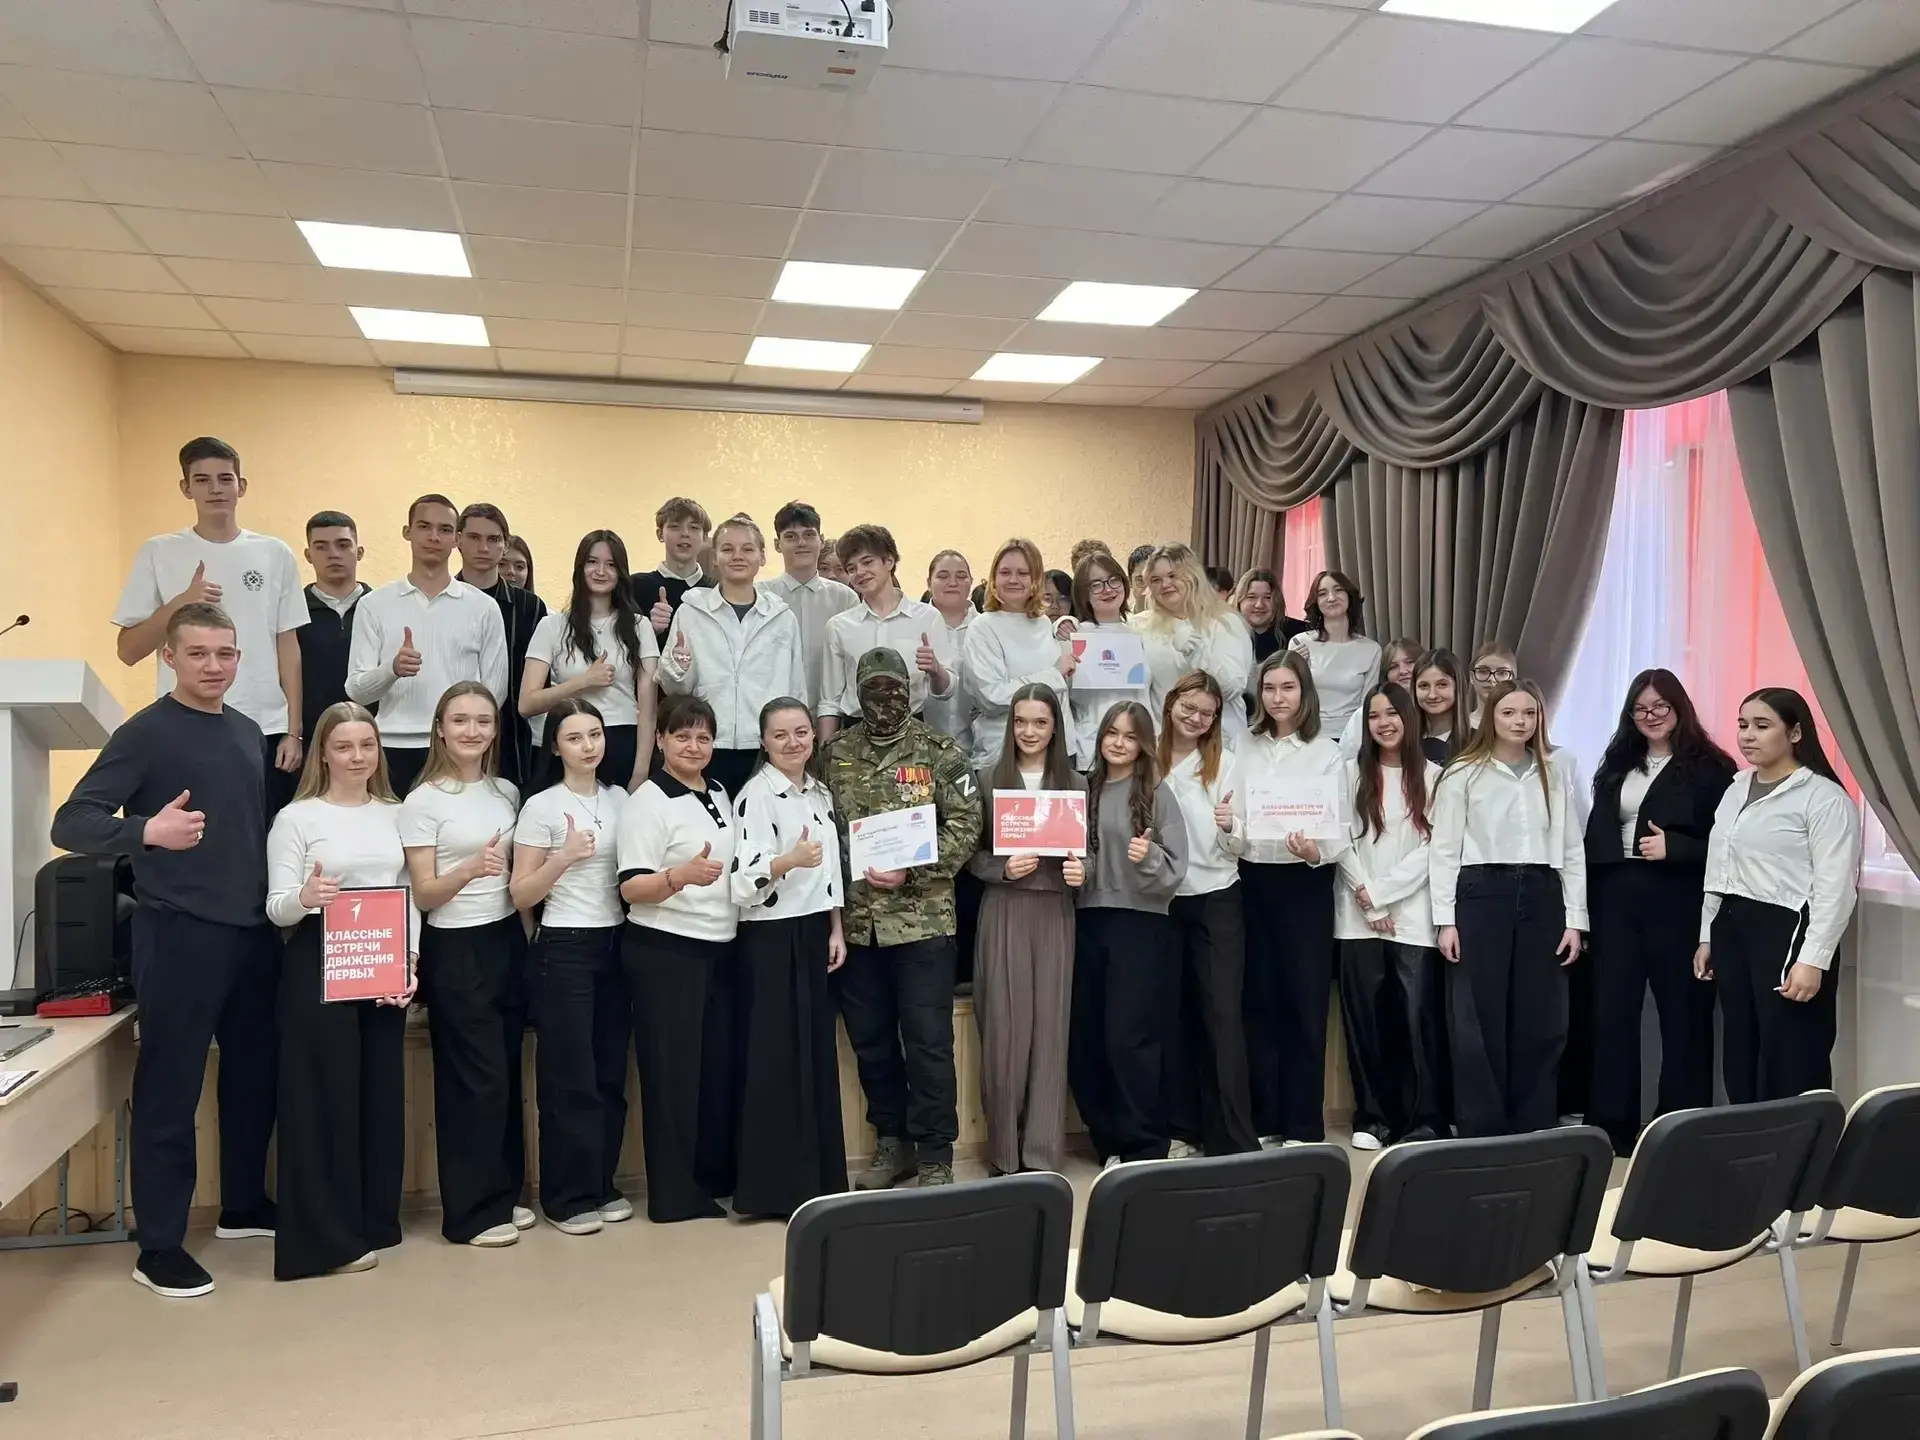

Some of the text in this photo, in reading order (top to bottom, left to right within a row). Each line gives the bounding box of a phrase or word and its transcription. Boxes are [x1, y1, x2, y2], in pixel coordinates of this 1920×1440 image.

[955, 773, 977, 797] Z
[326, 928, 393, 942] КЛАССНЫЕ
[326, 941, 381, 955] ВСТРЕЧИ
[326, 953, 395, 969] ДВИЖЕНИЯ
[326, 967, 376, 981] ПЕРВЫХ
